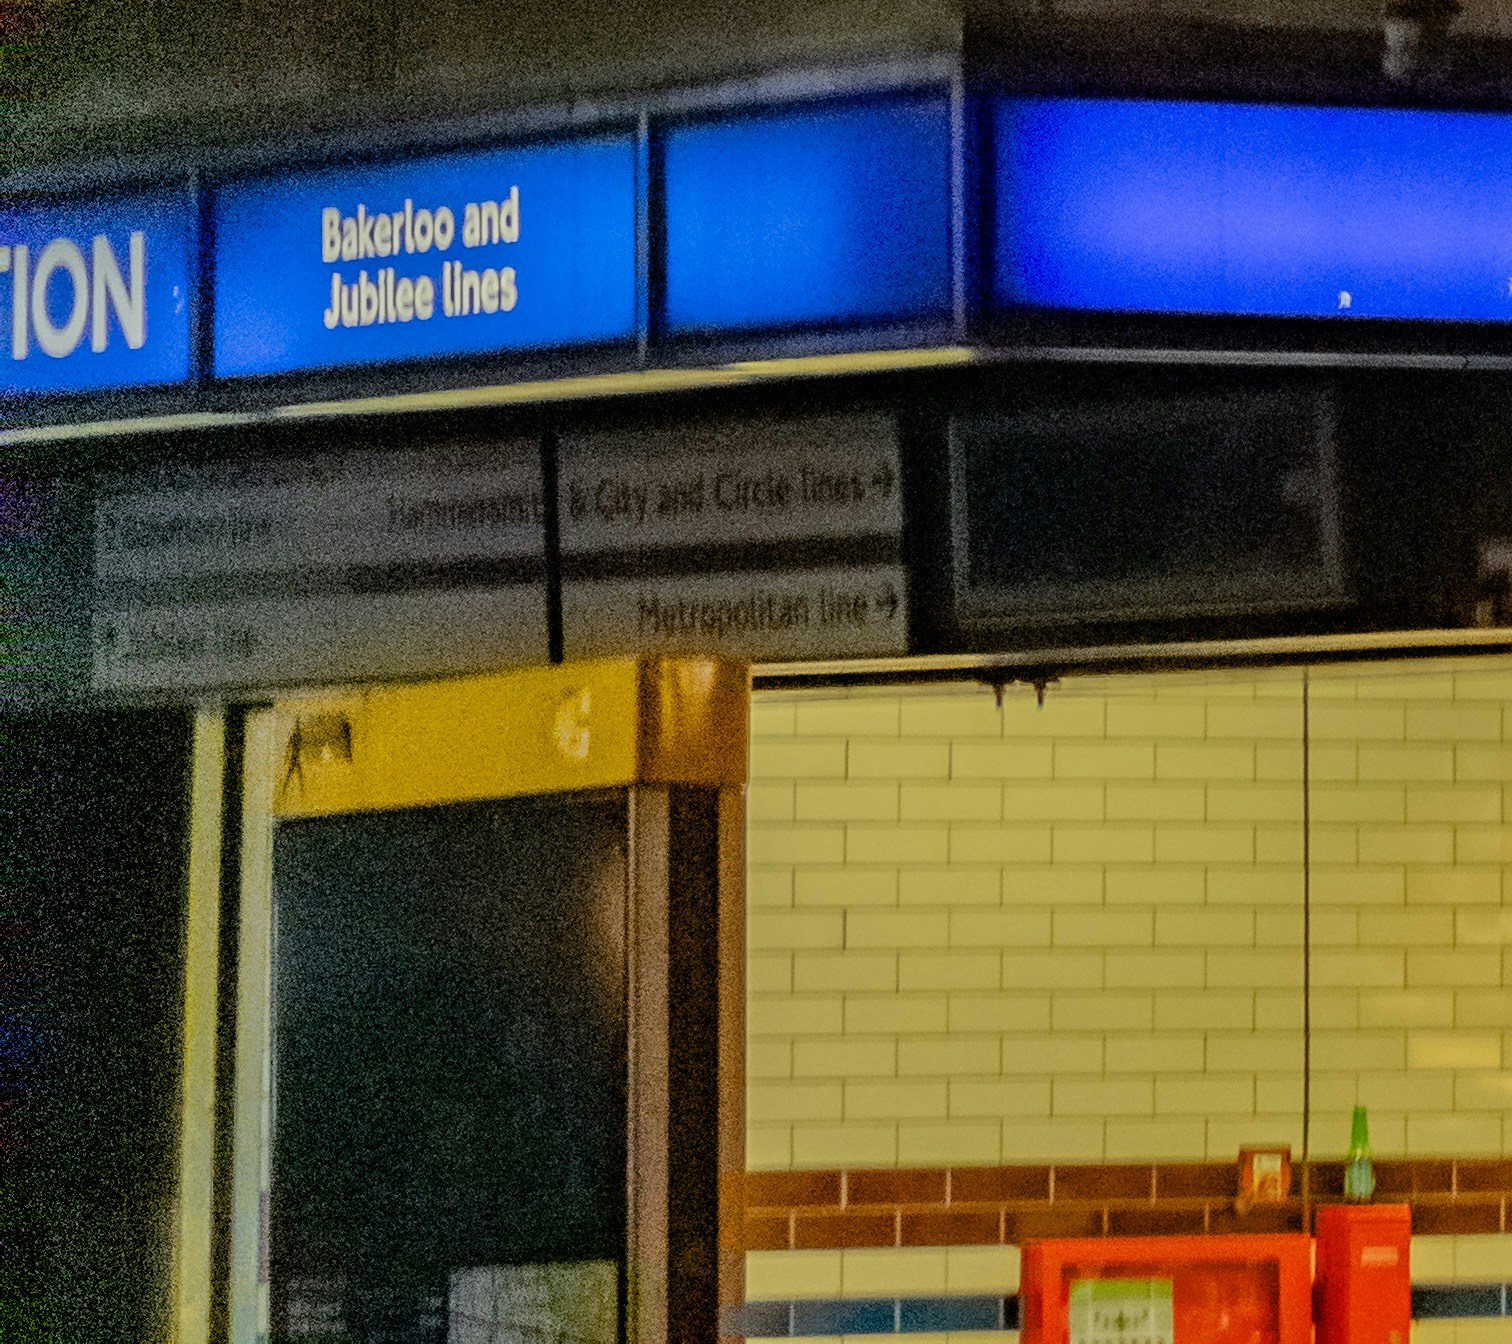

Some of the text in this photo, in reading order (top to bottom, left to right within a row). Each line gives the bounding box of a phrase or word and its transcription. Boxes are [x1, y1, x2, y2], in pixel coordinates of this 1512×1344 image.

[321, 185, 520, 263] Bakerloo and
[0, 230, 147, 360] ION
[323, 259, 518, 330] Jubilee lines
[594, 477, 648, 524] City
[657, 472, 705, 512] and
[714, 468, 793, 510] Circle
[800, 463, 865, 504] lines
[637, 585, 868, 639] Metropolitan line
